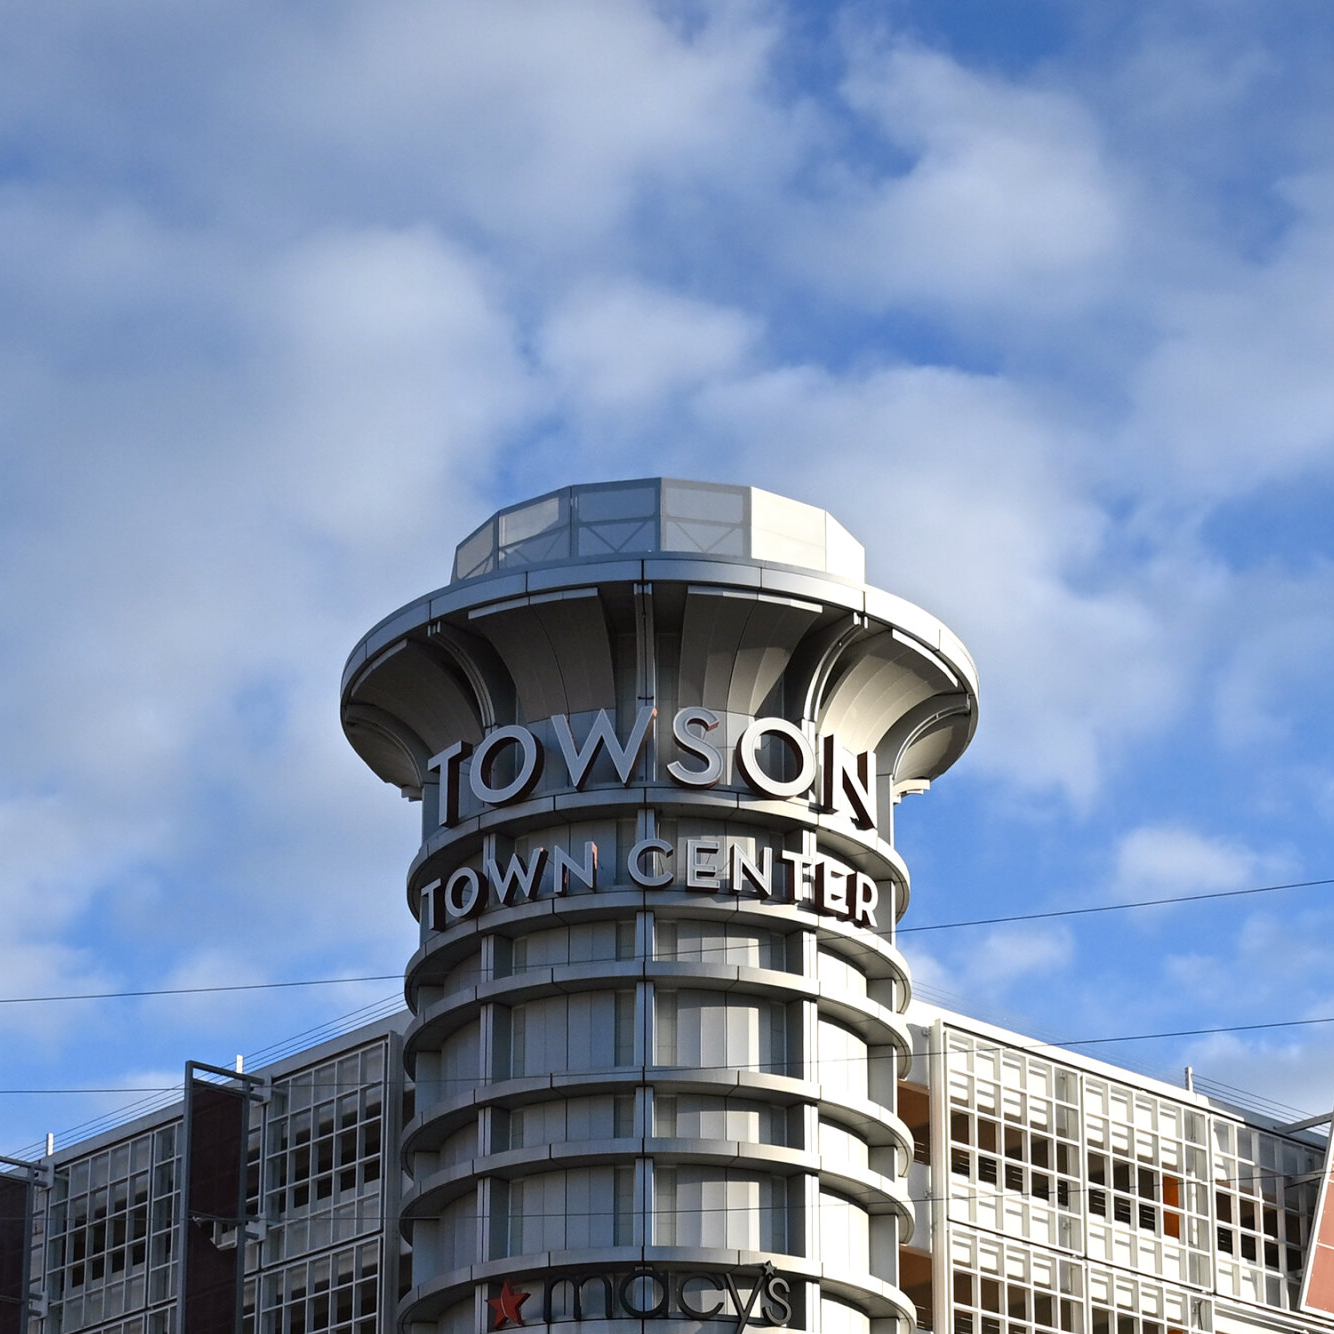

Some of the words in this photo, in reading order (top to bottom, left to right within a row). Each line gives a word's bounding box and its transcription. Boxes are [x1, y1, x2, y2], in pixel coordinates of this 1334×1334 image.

[428, 706, 876, 830] TOWSON
[421, 841, 598, 931] TOWN
[627, 838, 879, 928] CENTER
